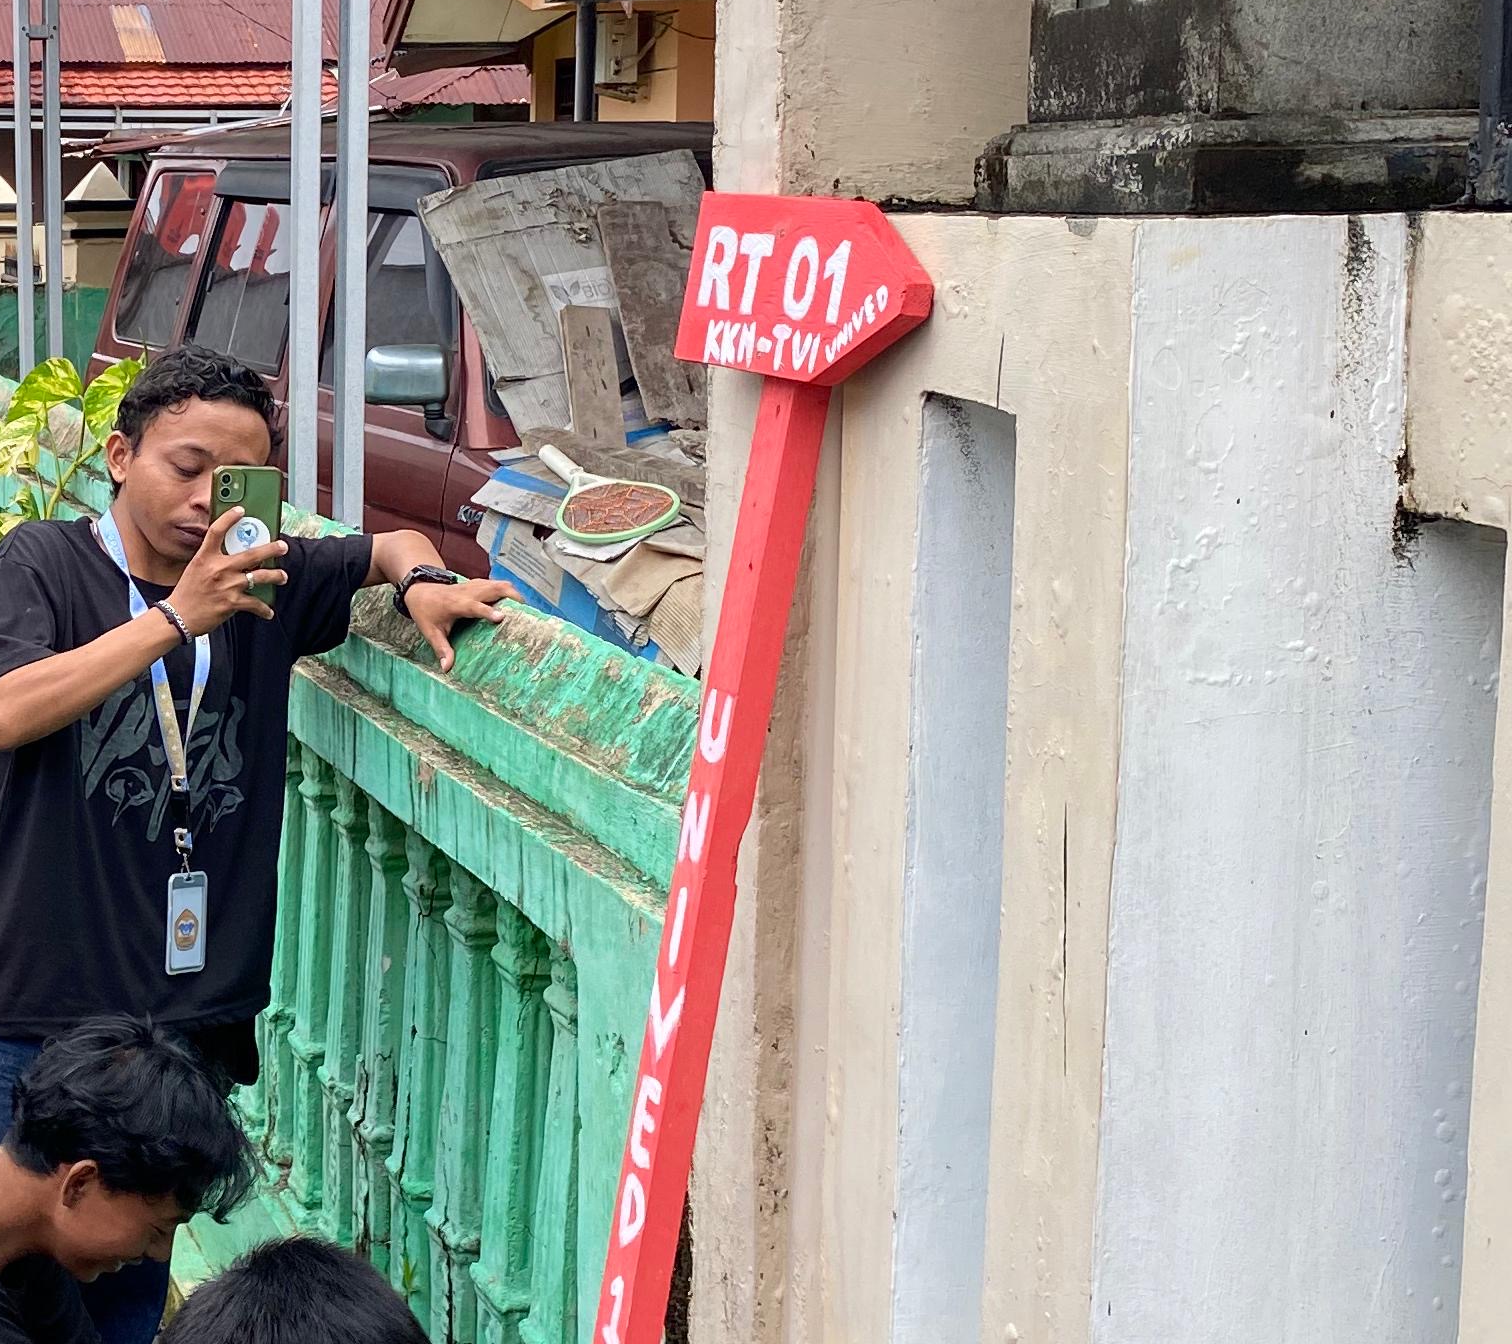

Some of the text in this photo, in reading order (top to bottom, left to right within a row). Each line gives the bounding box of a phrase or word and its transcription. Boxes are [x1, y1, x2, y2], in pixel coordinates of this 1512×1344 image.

[697, 225, 852, 325] RT 01
[824, 284, 889, 363] UNIVED
[456, 504, 484, 527] Kija
